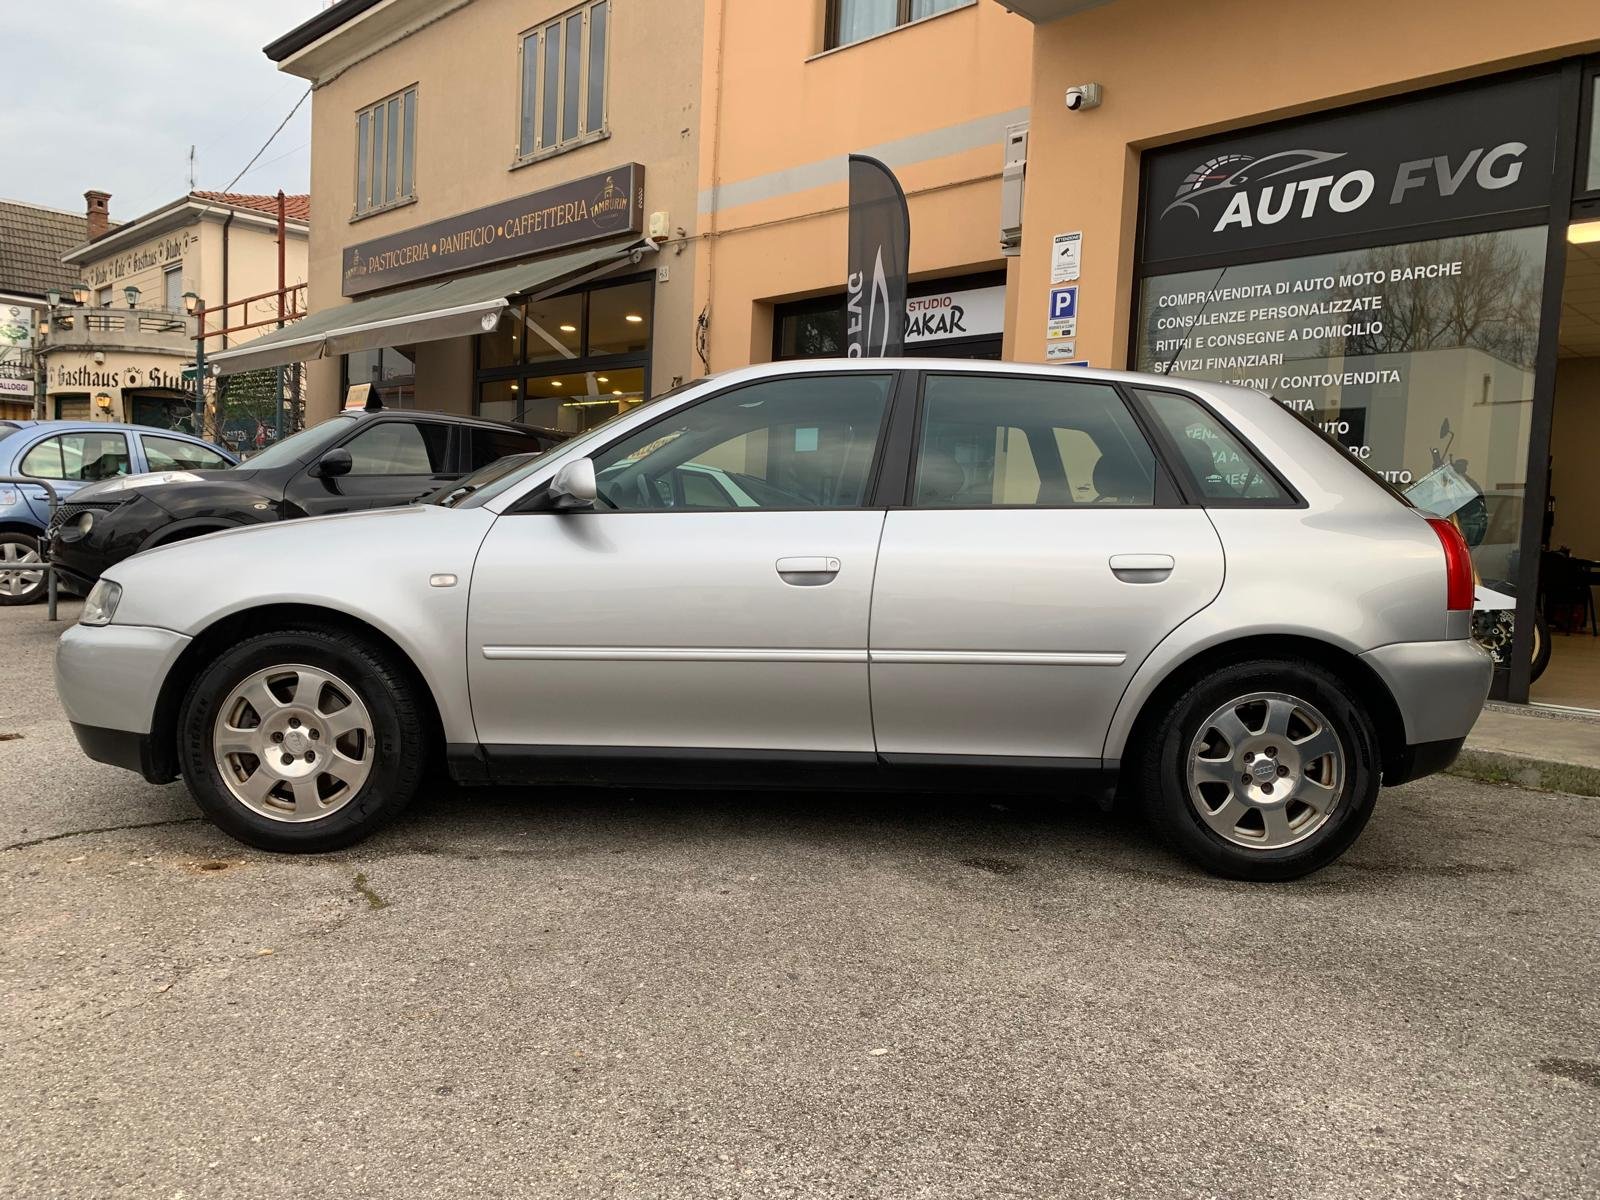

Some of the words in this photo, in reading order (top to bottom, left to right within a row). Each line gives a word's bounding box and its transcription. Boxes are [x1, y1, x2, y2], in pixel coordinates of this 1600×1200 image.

[1213, 170, 1375, 232] AUTO
[1390, 142, 1528, 205] FVG
[368, 243, 430, 274] PASTICCERIA
[439, 224, 495, 256] PANIFICIO
[504, 199, 588, 239] CAFFETTERIA
[1158, 284, 1272, 308] COMPRAVENDITA
[1276, 282, 1290, 295] DI
[1293, 276, 1335, 293] AUTO
[1339, 270, 1386, 287] MOTO
[1390, 261, 1463, 282] BARCHE
[908, 296, 952, 312] STUDIO
[1055, 292, 1071, 317] P
[1157, 310, 1246, 330] CONSULENZE
[1250, 296, 1383, 321] PERSONALIZZATE
[1156, 338, 1192, 352] RITIRI
[1196, 337, 1204, 348] E
[1207, 330, 1285, 348] CONSEGNE
[1288, 329, 1299, 341] A
[1302, 321, 1383, 340] DOMICILIO
[58, 365, 119, 388] Gasthaus
[1154, 358, 1202, 373] SERVIZI
[1206, 353, 1284, 370] FINANZIARI
[1280, 369, 1400, 389] CONTOVENDITA
